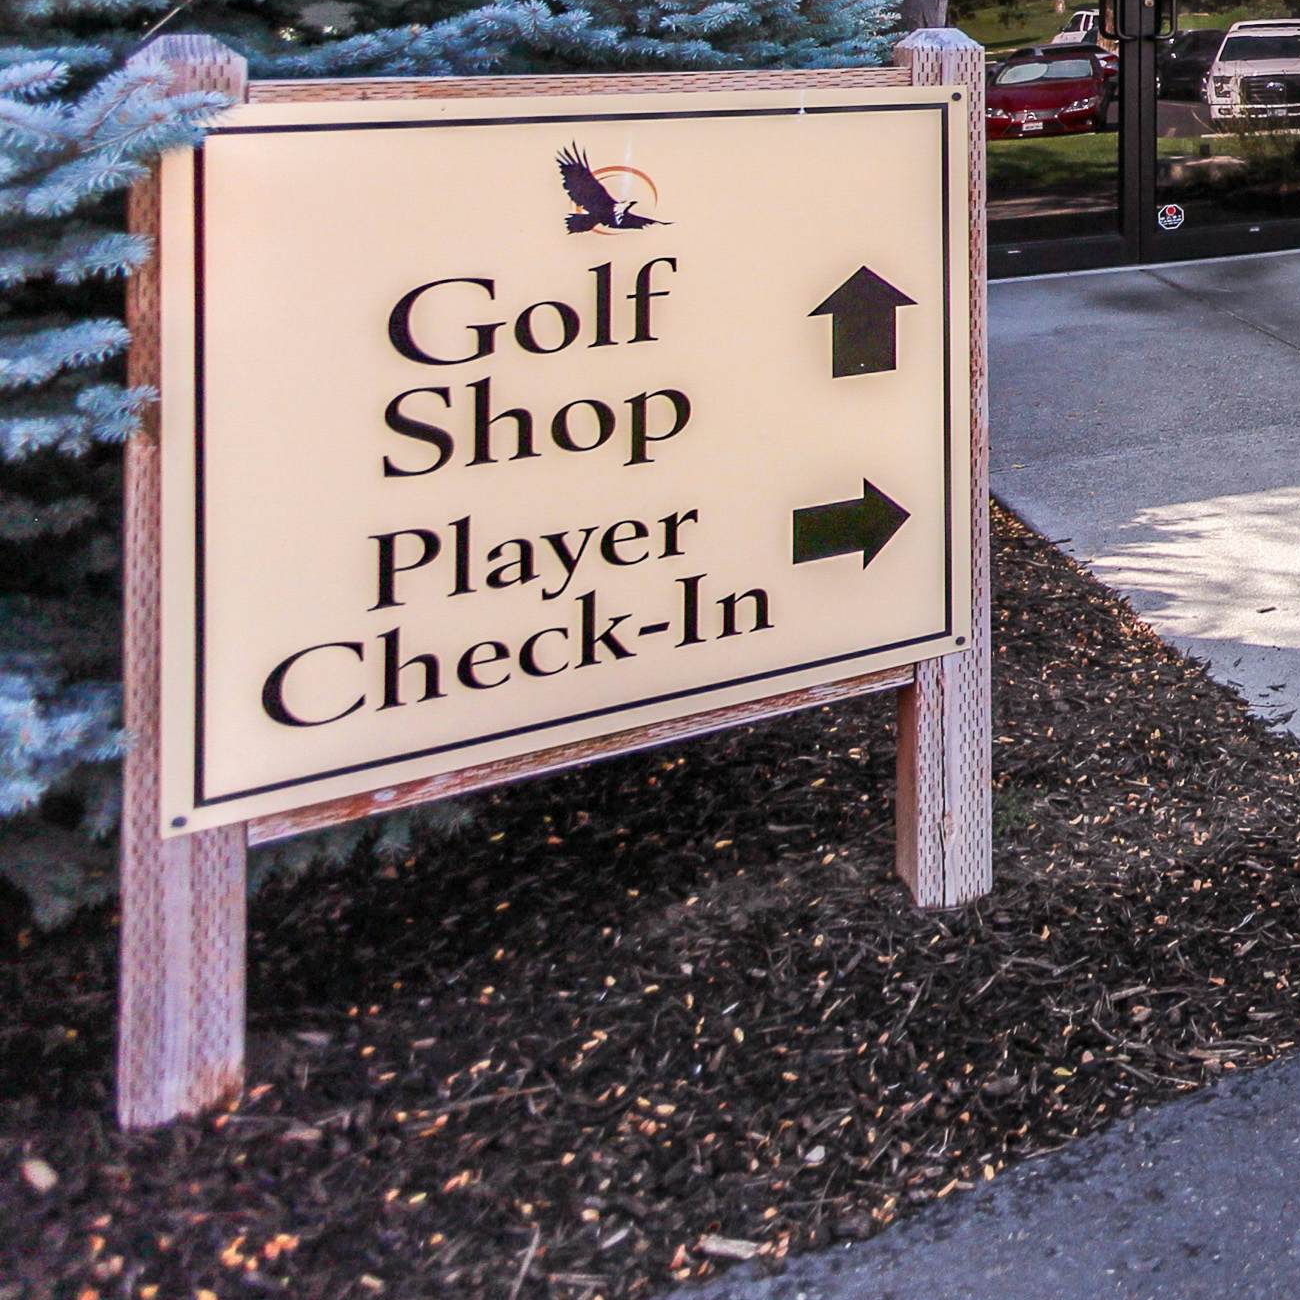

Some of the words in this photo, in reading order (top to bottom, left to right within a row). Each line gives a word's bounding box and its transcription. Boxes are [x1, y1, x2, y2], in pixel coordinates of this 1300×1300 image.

[388, 257, 678, 366] Golf
[382, 376, 692, 478] Shop
[366, 507, 700, 612] Player
[260, 572, 775, 729] Check-In
